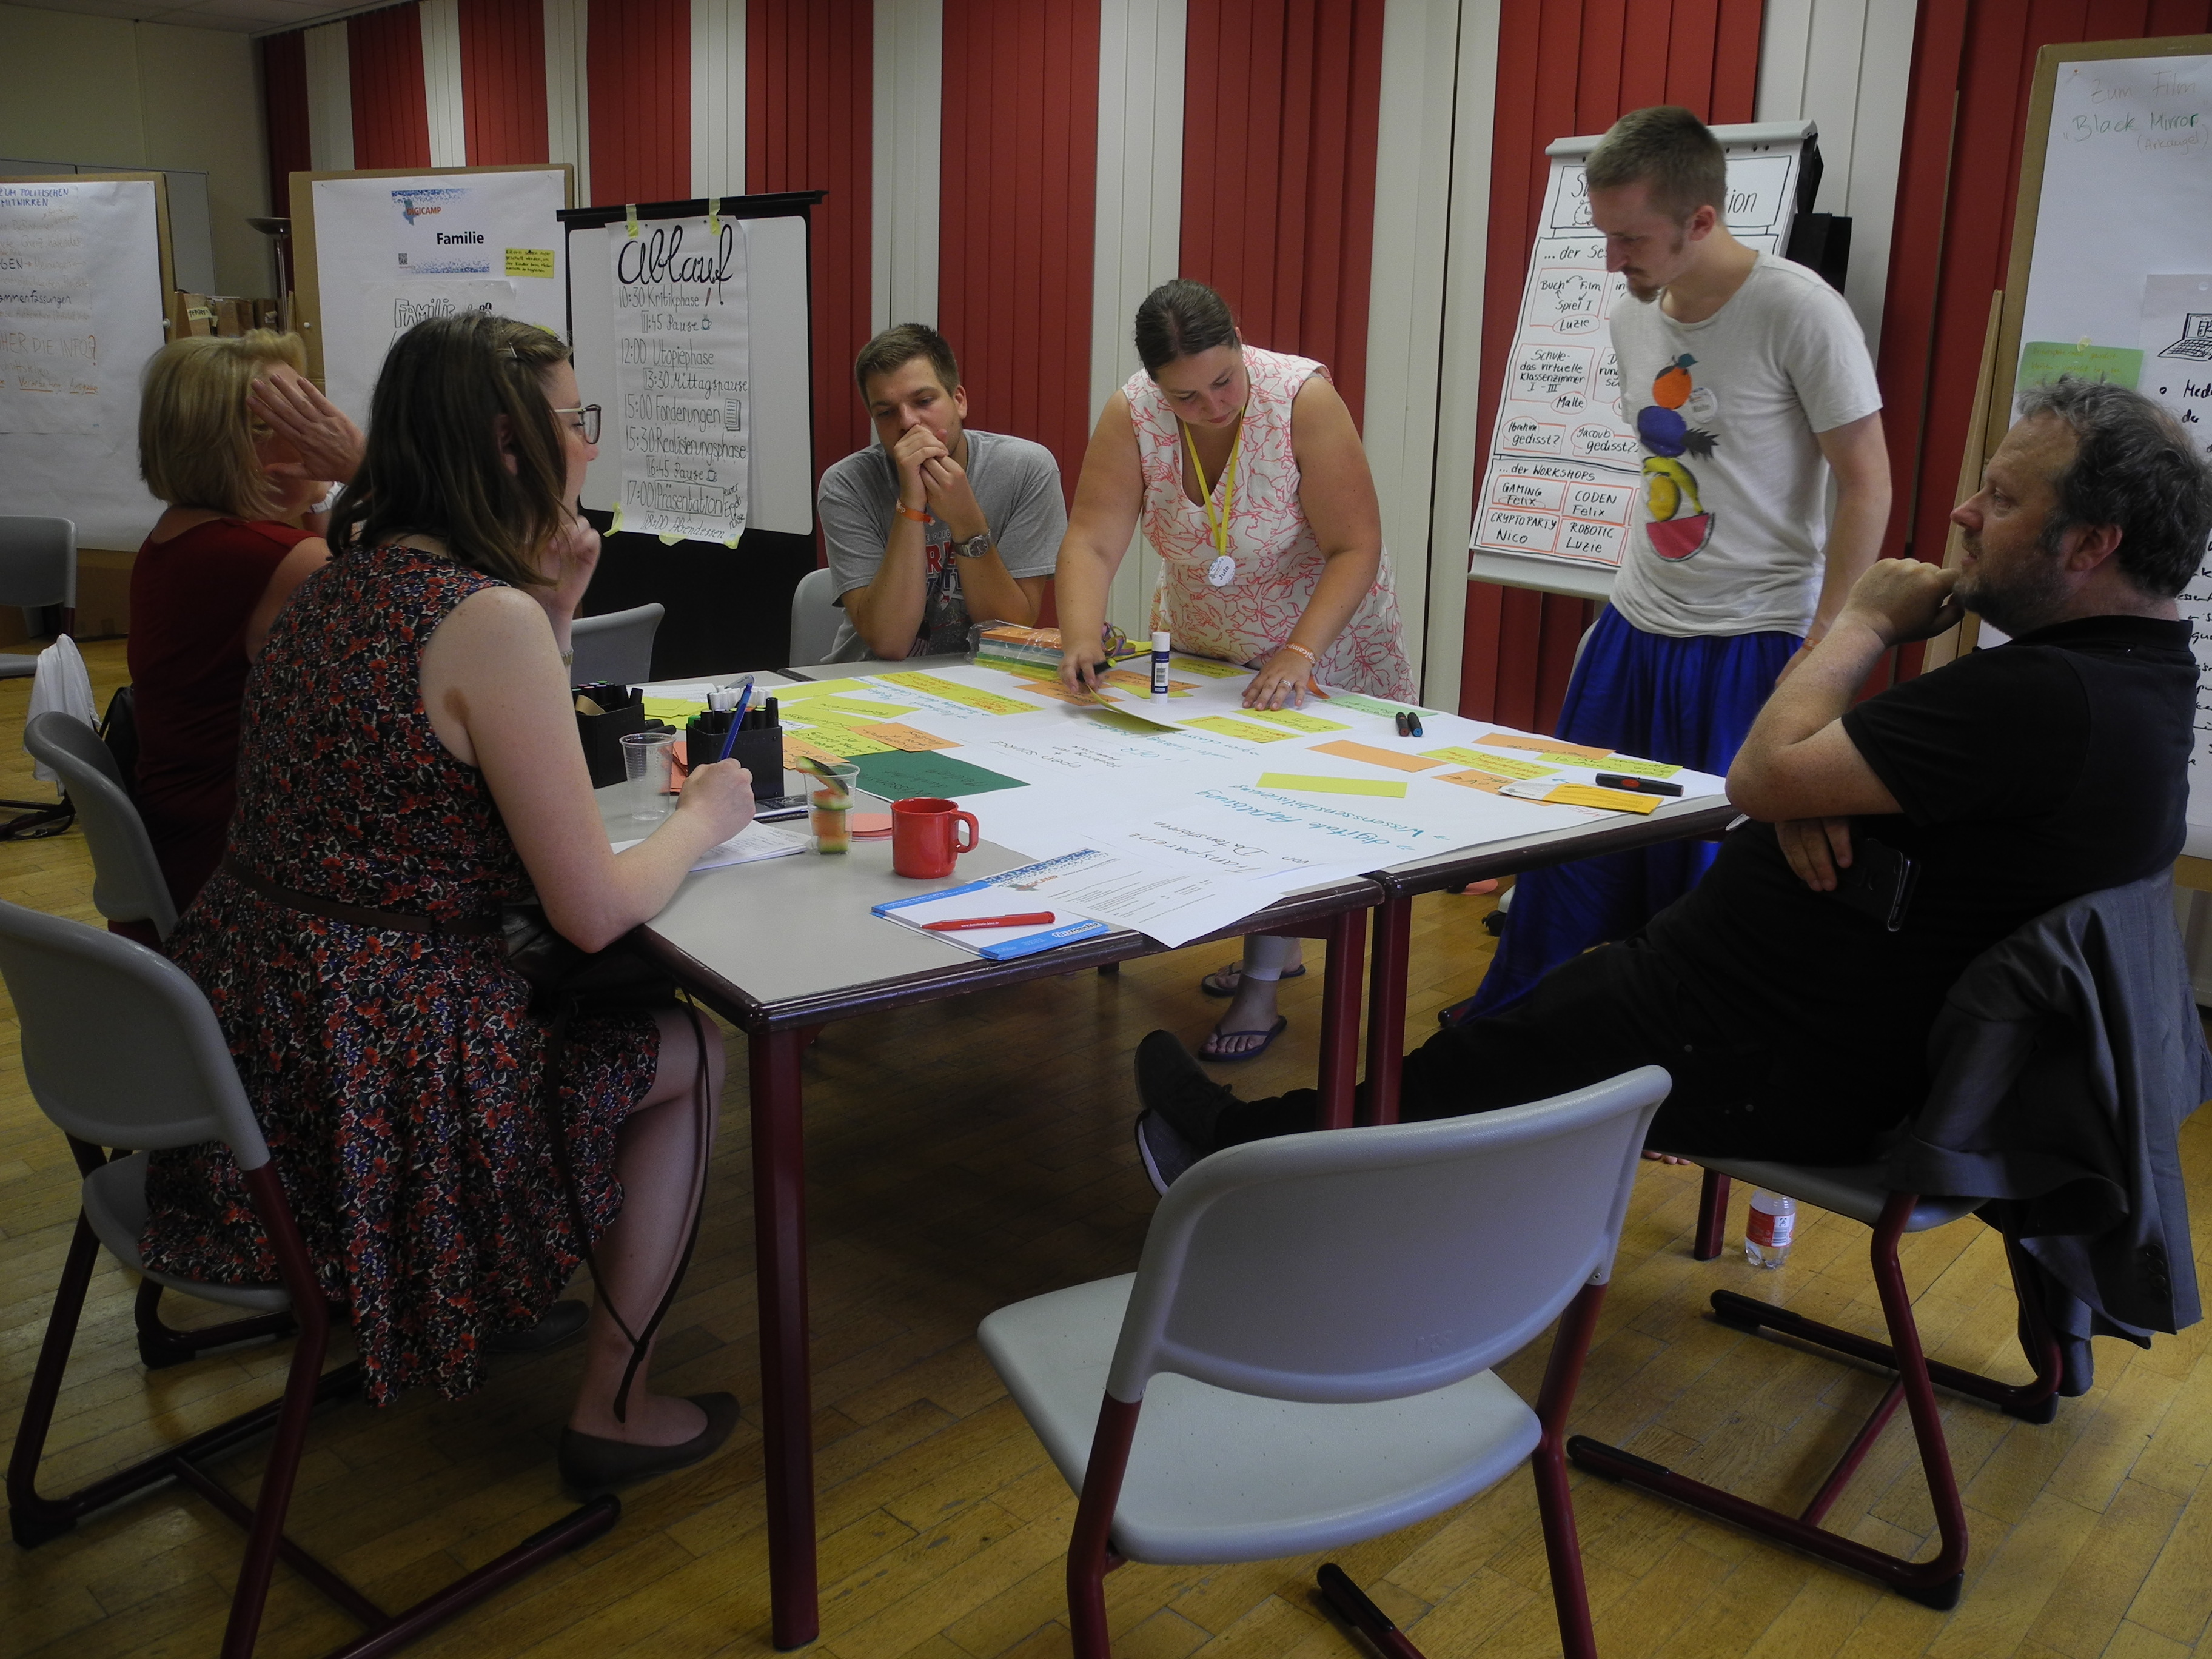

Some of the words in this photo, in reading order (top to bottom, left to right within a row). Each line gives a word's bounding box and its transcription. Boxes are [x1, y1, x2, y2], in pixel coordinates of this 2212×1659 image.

[2152, 70, 2196, 97] Film
[20, 187, 69, 198] POLITISCHEN
[1, 198, 49, 207] MITWIRKEN
[406, 206, 442, 215] DIGICAMP
[437, 231, 484, 245] Familie
[1559, 246, 1581, 260] der
[0, 258, 23, 270] GEN
[1580, 281, 1601, 291] Film
[0, 290, 72, 309] ammenfassungen
[618, 286, 645, 308] 10:30
[647, 283, 700, 313] Kritikphase
[1555, 300, 1581, 313] Spiel
[667, 313, 700, 332] Pause
[1559, 317, 1590, 332] Luzie
[0, 331, 29, 354] HER
[32, 337, 55, 355] DIE
[621, 338, 647, 364] 12:00
[652, 338, 714, 371] Utopiephase
[1520, 361, 1537, 372] das
[1541, 361, 1583, 374] virtuelle
[643, 369, 669, 390] 13:30
[671, 372, 748, 400] Mittagspause
[1520, 371, 1586, 384] Klassenzimmer
[1555, 395, 1584, 409] Malte
[625, 394, 652, 420] 15:00
[656, 395, 721, 432] Forderungen
[625, 424, 655, 453] 15:30
[655, 427, 748, 466] Realisierungsphase
[1512, 434, 1560, 447] gedisst?
[674, 462, 704, 480] Pause
[1511, 463, 1529, 475] der
[1533, 464, 1596, 481] WORKSHOPS
[1502, 481, 1543, 497] GAMING
[627, 480, 654, 508] 17:00
[657, 482, 723, 514] Präsentation
[1507, 495, 1537, 506] Felix
[1575, 490, 1618, 504] CODEN
[1572, 504, 1606, 517] Felix
[669, 517, 726, 539] Abendessen
[933, 529, 951, 541] ORIG
[1569, 521, 1615, 539] ROBOTIC
[1566, 536, 1603, 554] Luzie
[1219, 565, 1230, 580] Jule
[1307, 822, 1390, 845] digitale
[1128, 833, 1262, 874] Transparenz
[1281, 856, 1310, 865] von
